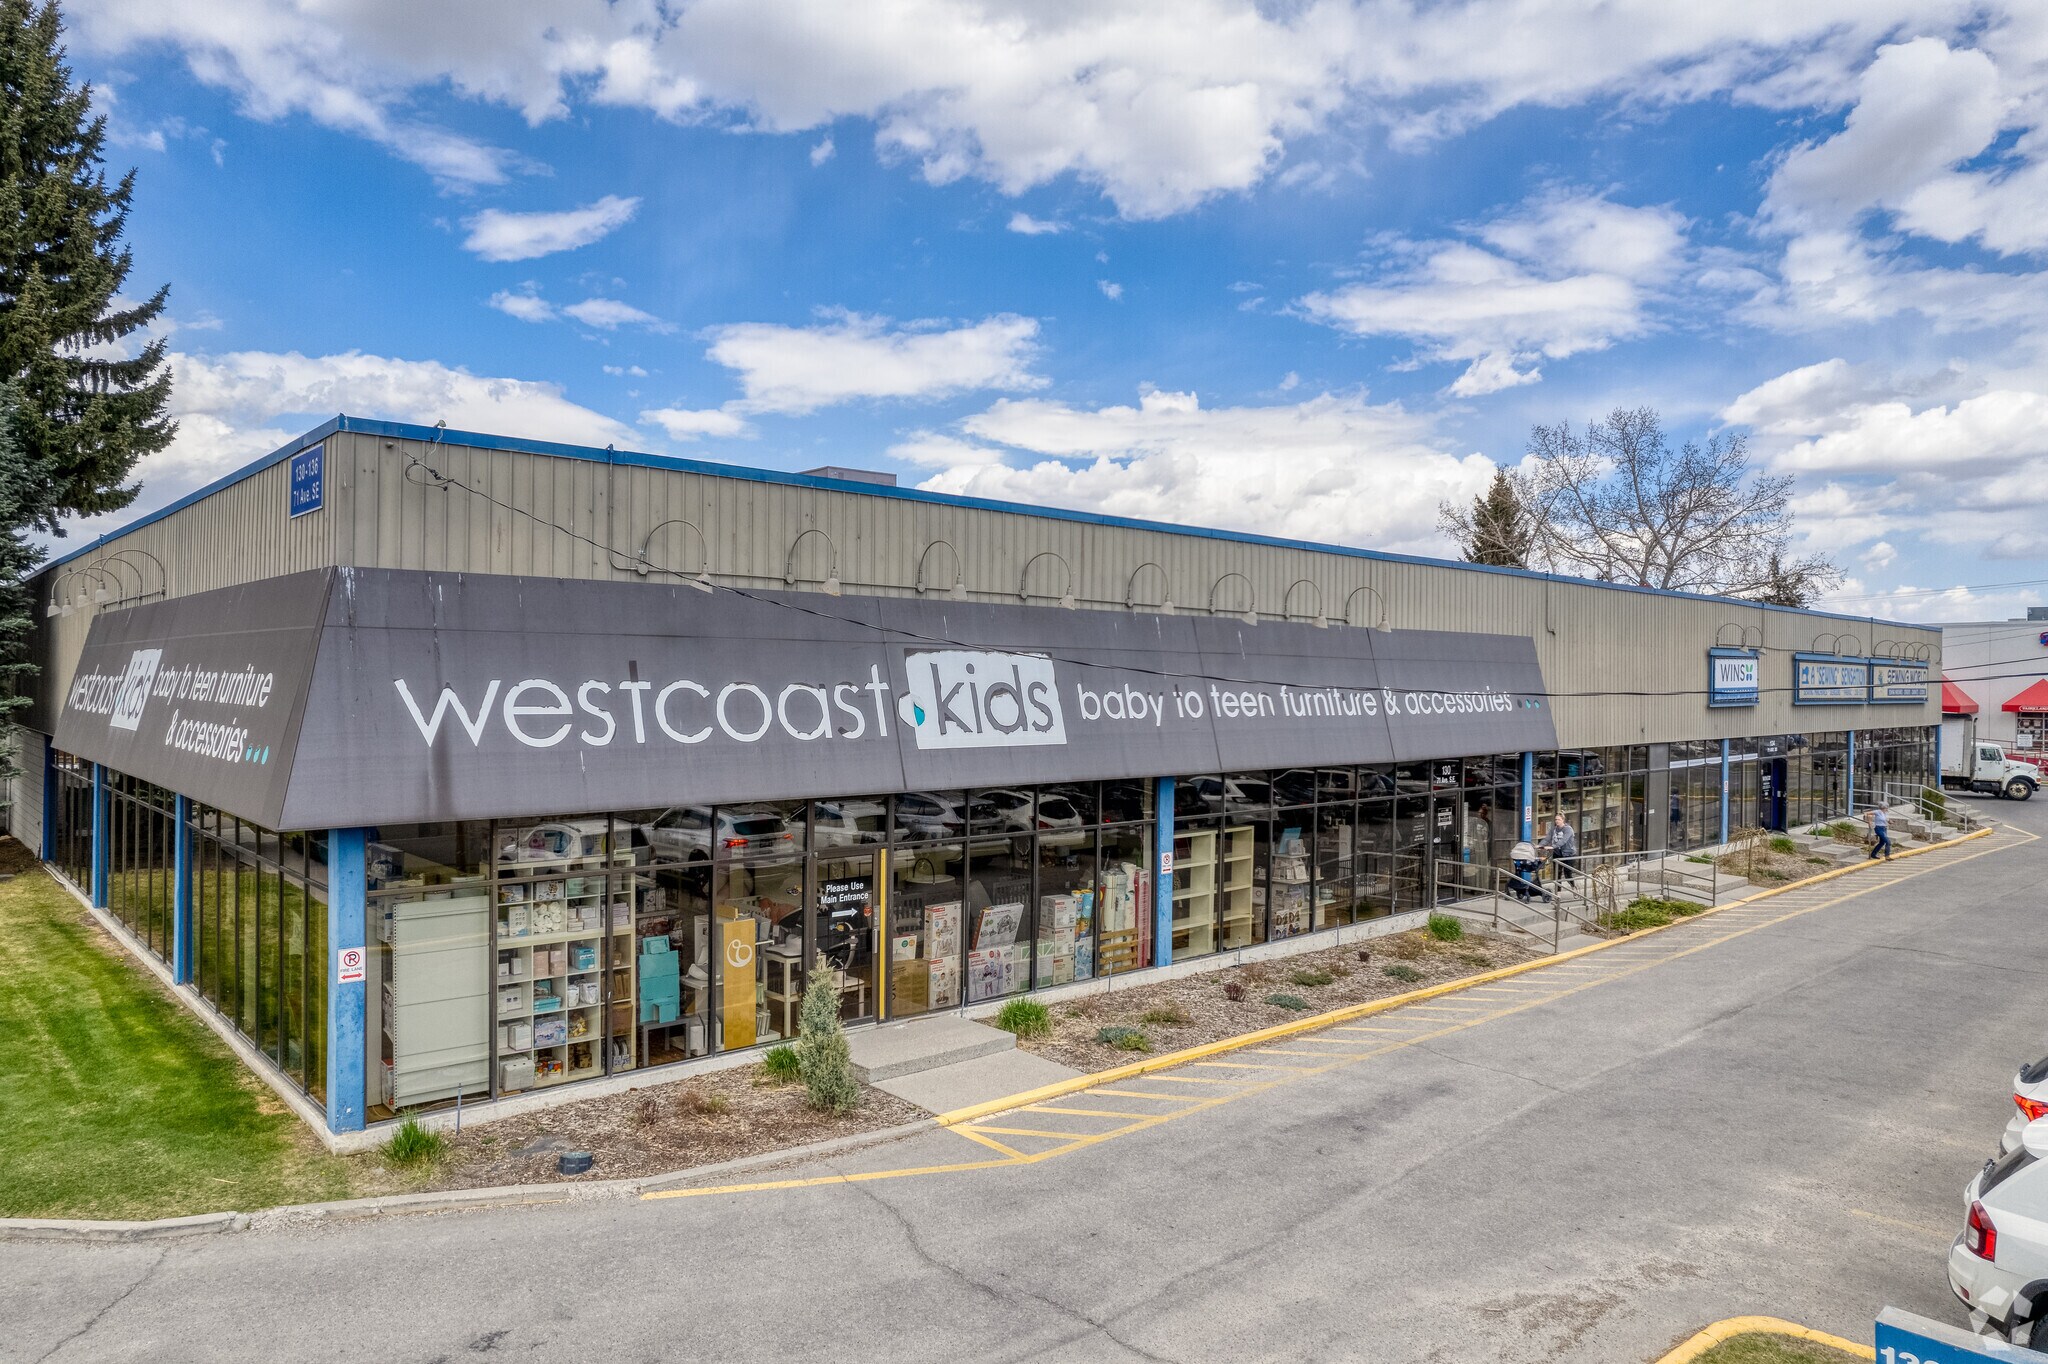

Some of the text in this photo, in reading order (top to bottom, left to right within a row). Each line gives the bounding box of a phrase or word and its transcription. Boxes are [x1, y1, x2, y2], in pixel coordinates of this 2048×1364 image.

[295, 457, 319, 482] 130-136
[293, 490, 300, 506] 71
[312, 481, 319, 500] SE
[1720, 663, 1745, 682] WINS
[68, 664, 127, 715] westcoast
[152, 663, 180, 705] baby
[177, 663, 193, 699] to
[192, 663, 218, 702] teen
[393, 661, 890, 748] westcoast
[929, 661, 1055, 737] kids
[1076, 683, 1164, 727] baby
[1210, 684, 1276, 718] teen
[1279, 684, 1378, 717] furniture
[1383, 685, 1401, 715] &
[1405, 685, 1513, 716] accessories
[165, 708, 248, 763] & accessories
[1441, 765, 1452, 775] 130
[820, 892, 869, 904] Main Entrance
[826, 881, 864, 893] Please Use
